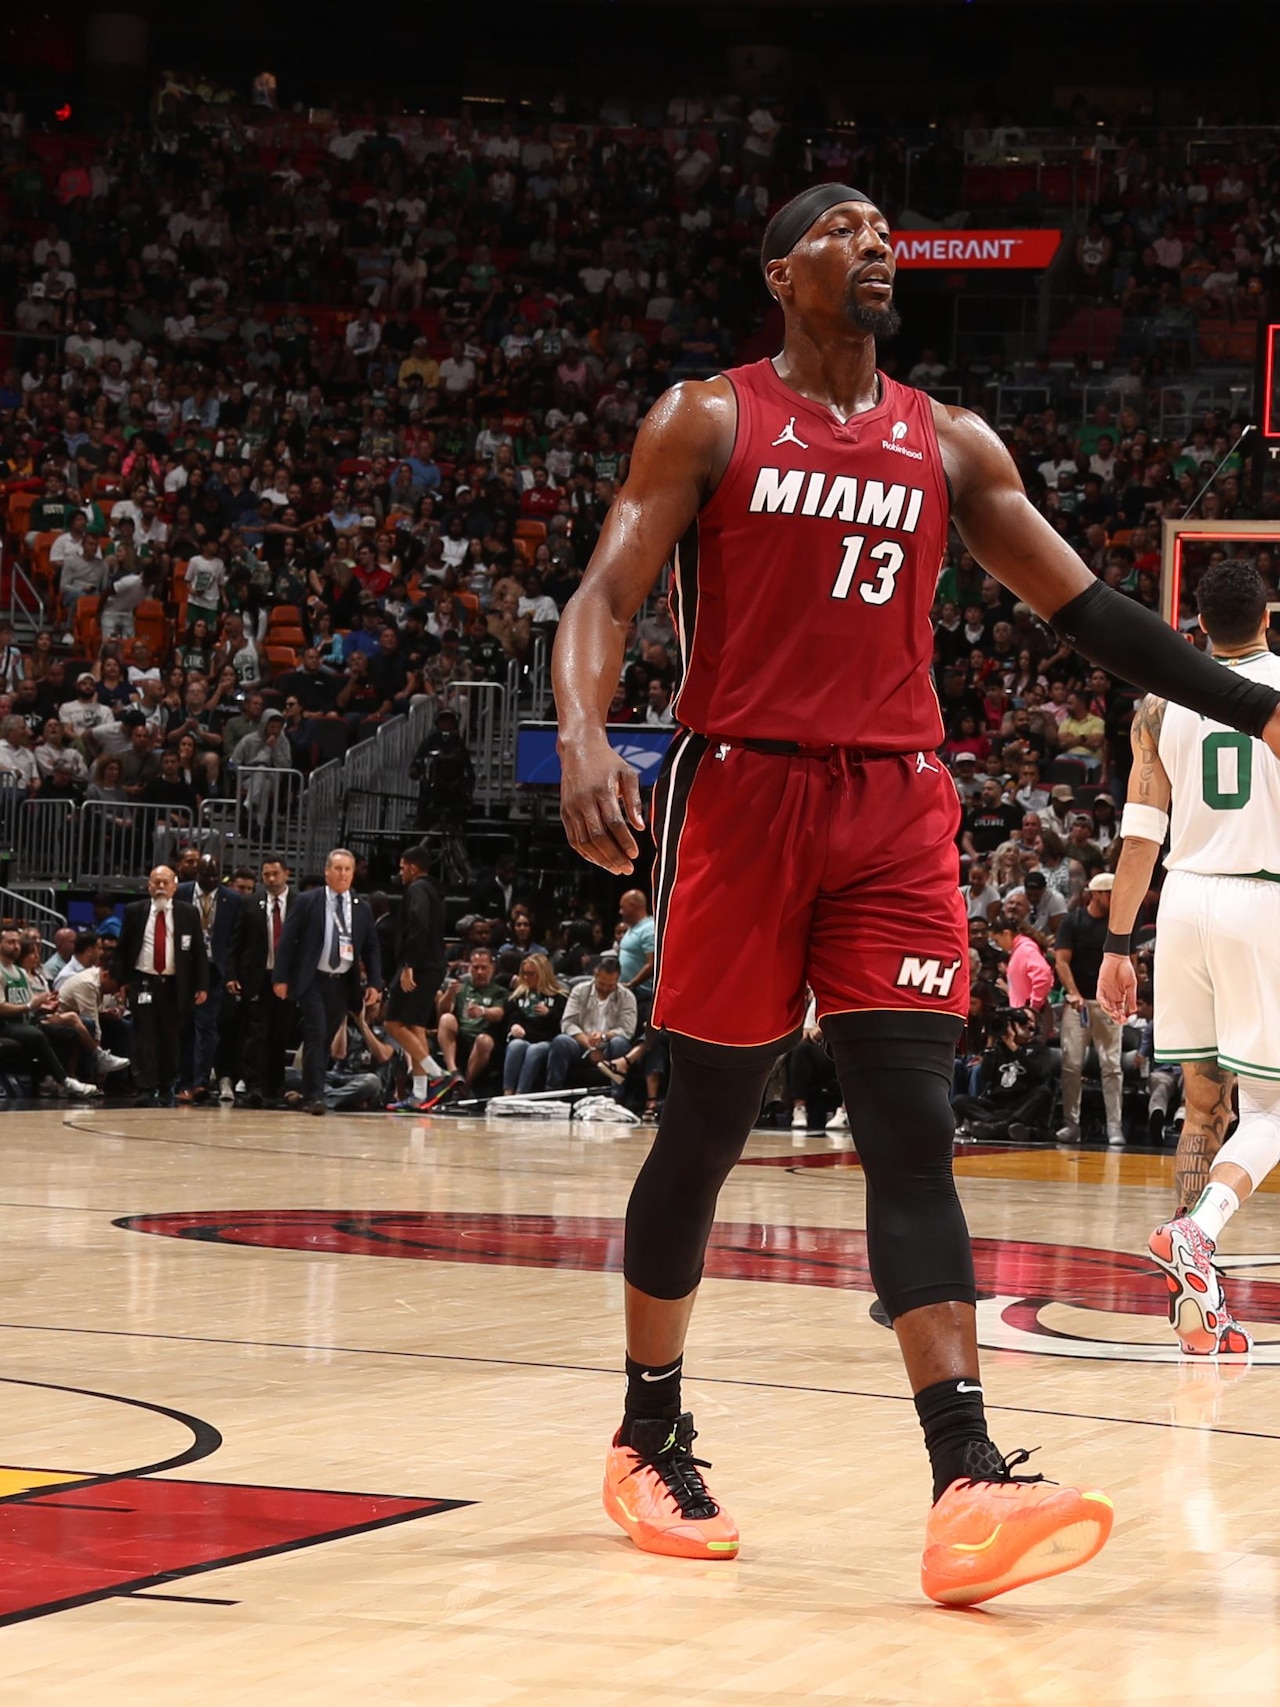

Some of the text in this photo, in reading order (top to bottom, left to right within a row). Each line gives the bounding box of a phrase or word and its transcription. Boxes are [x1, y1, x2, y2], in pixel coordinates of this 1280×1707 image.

[894, 239, 1015, 260] AMERANT
[882, 440, 923, 460] Robinhood
[748, 466, 924, 534] MIAMI
[830, 534, 905, 606] 13
[1202, 731, 1253, 810] 0
